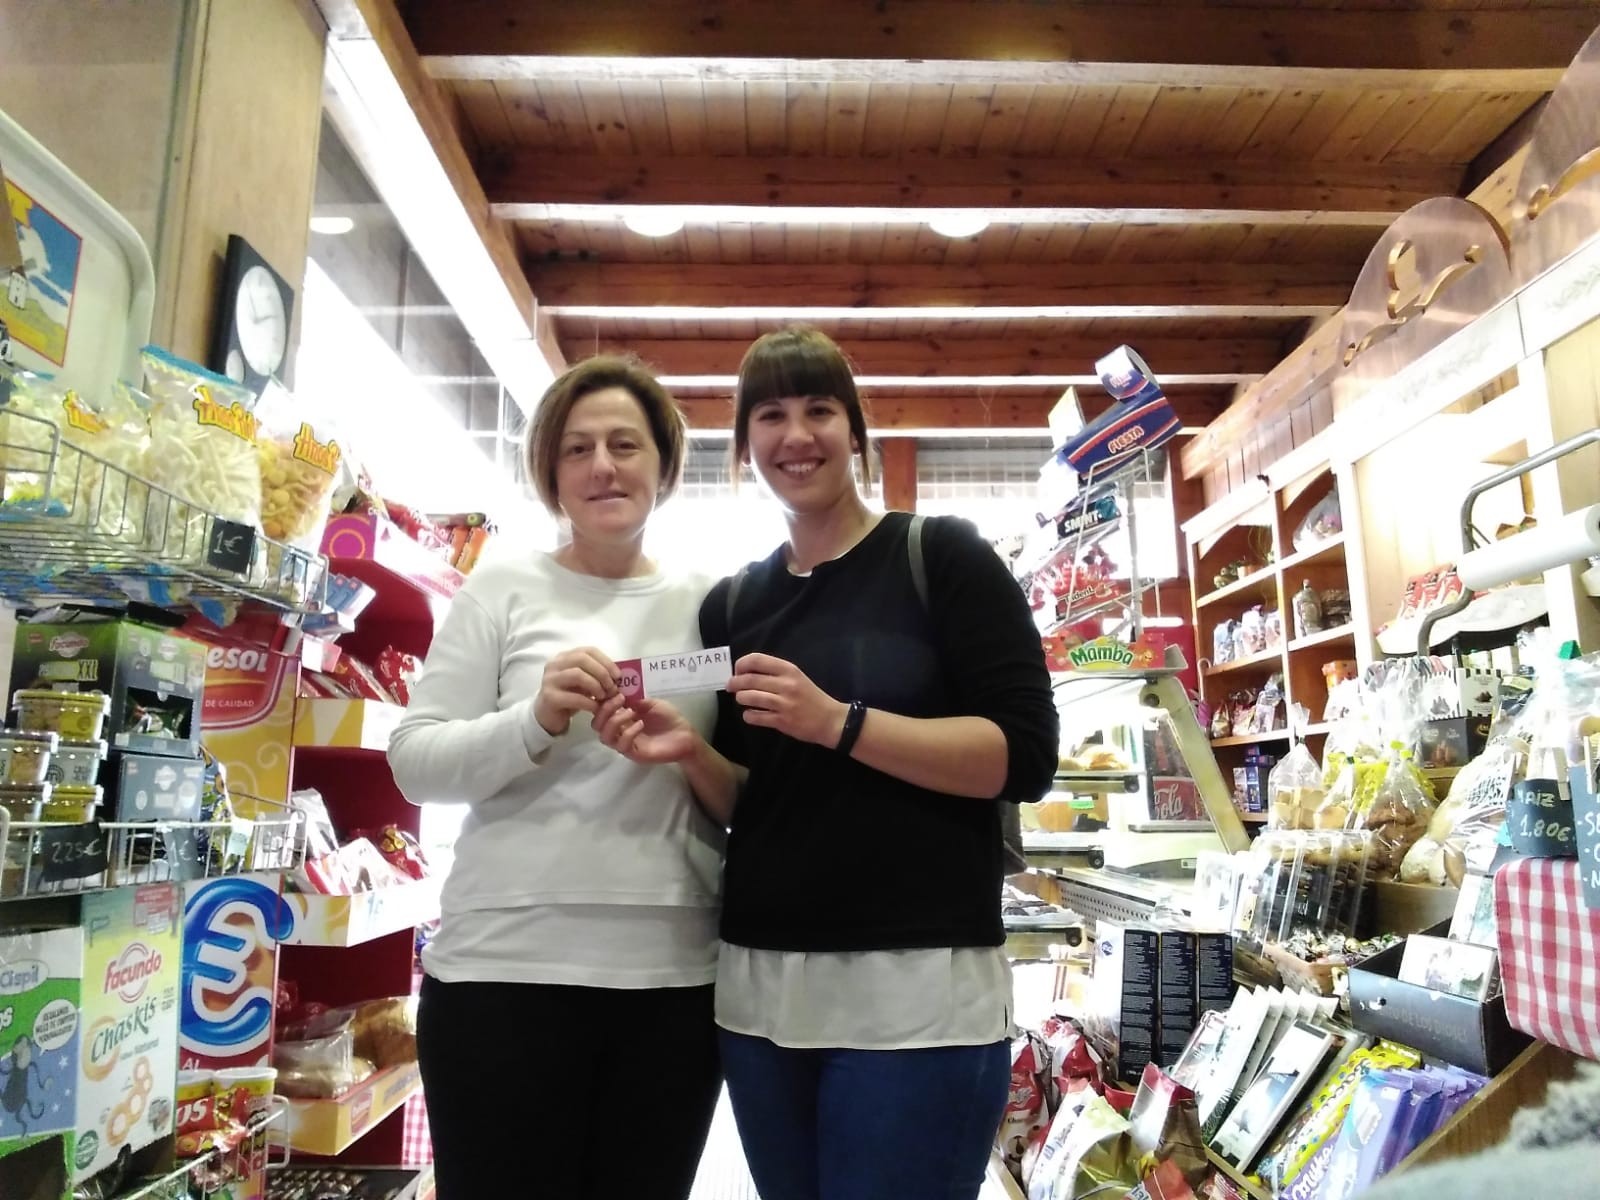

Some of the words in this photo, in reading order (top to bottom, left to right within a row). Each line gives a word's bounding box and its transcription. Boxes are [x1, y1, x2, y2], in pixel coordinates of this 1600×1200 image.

[1108, 426, 1144, 454] FIESTA
[214, 529, 243, 555] 1€
[1064, 585, 1095, 605] Tident
[207, 646, 269, 673] esol
[1070, 638, 1133, 667] Mamba
[105, 949, 162, 995] Facundo
[91, 995, 158, 1064] Chaskis
